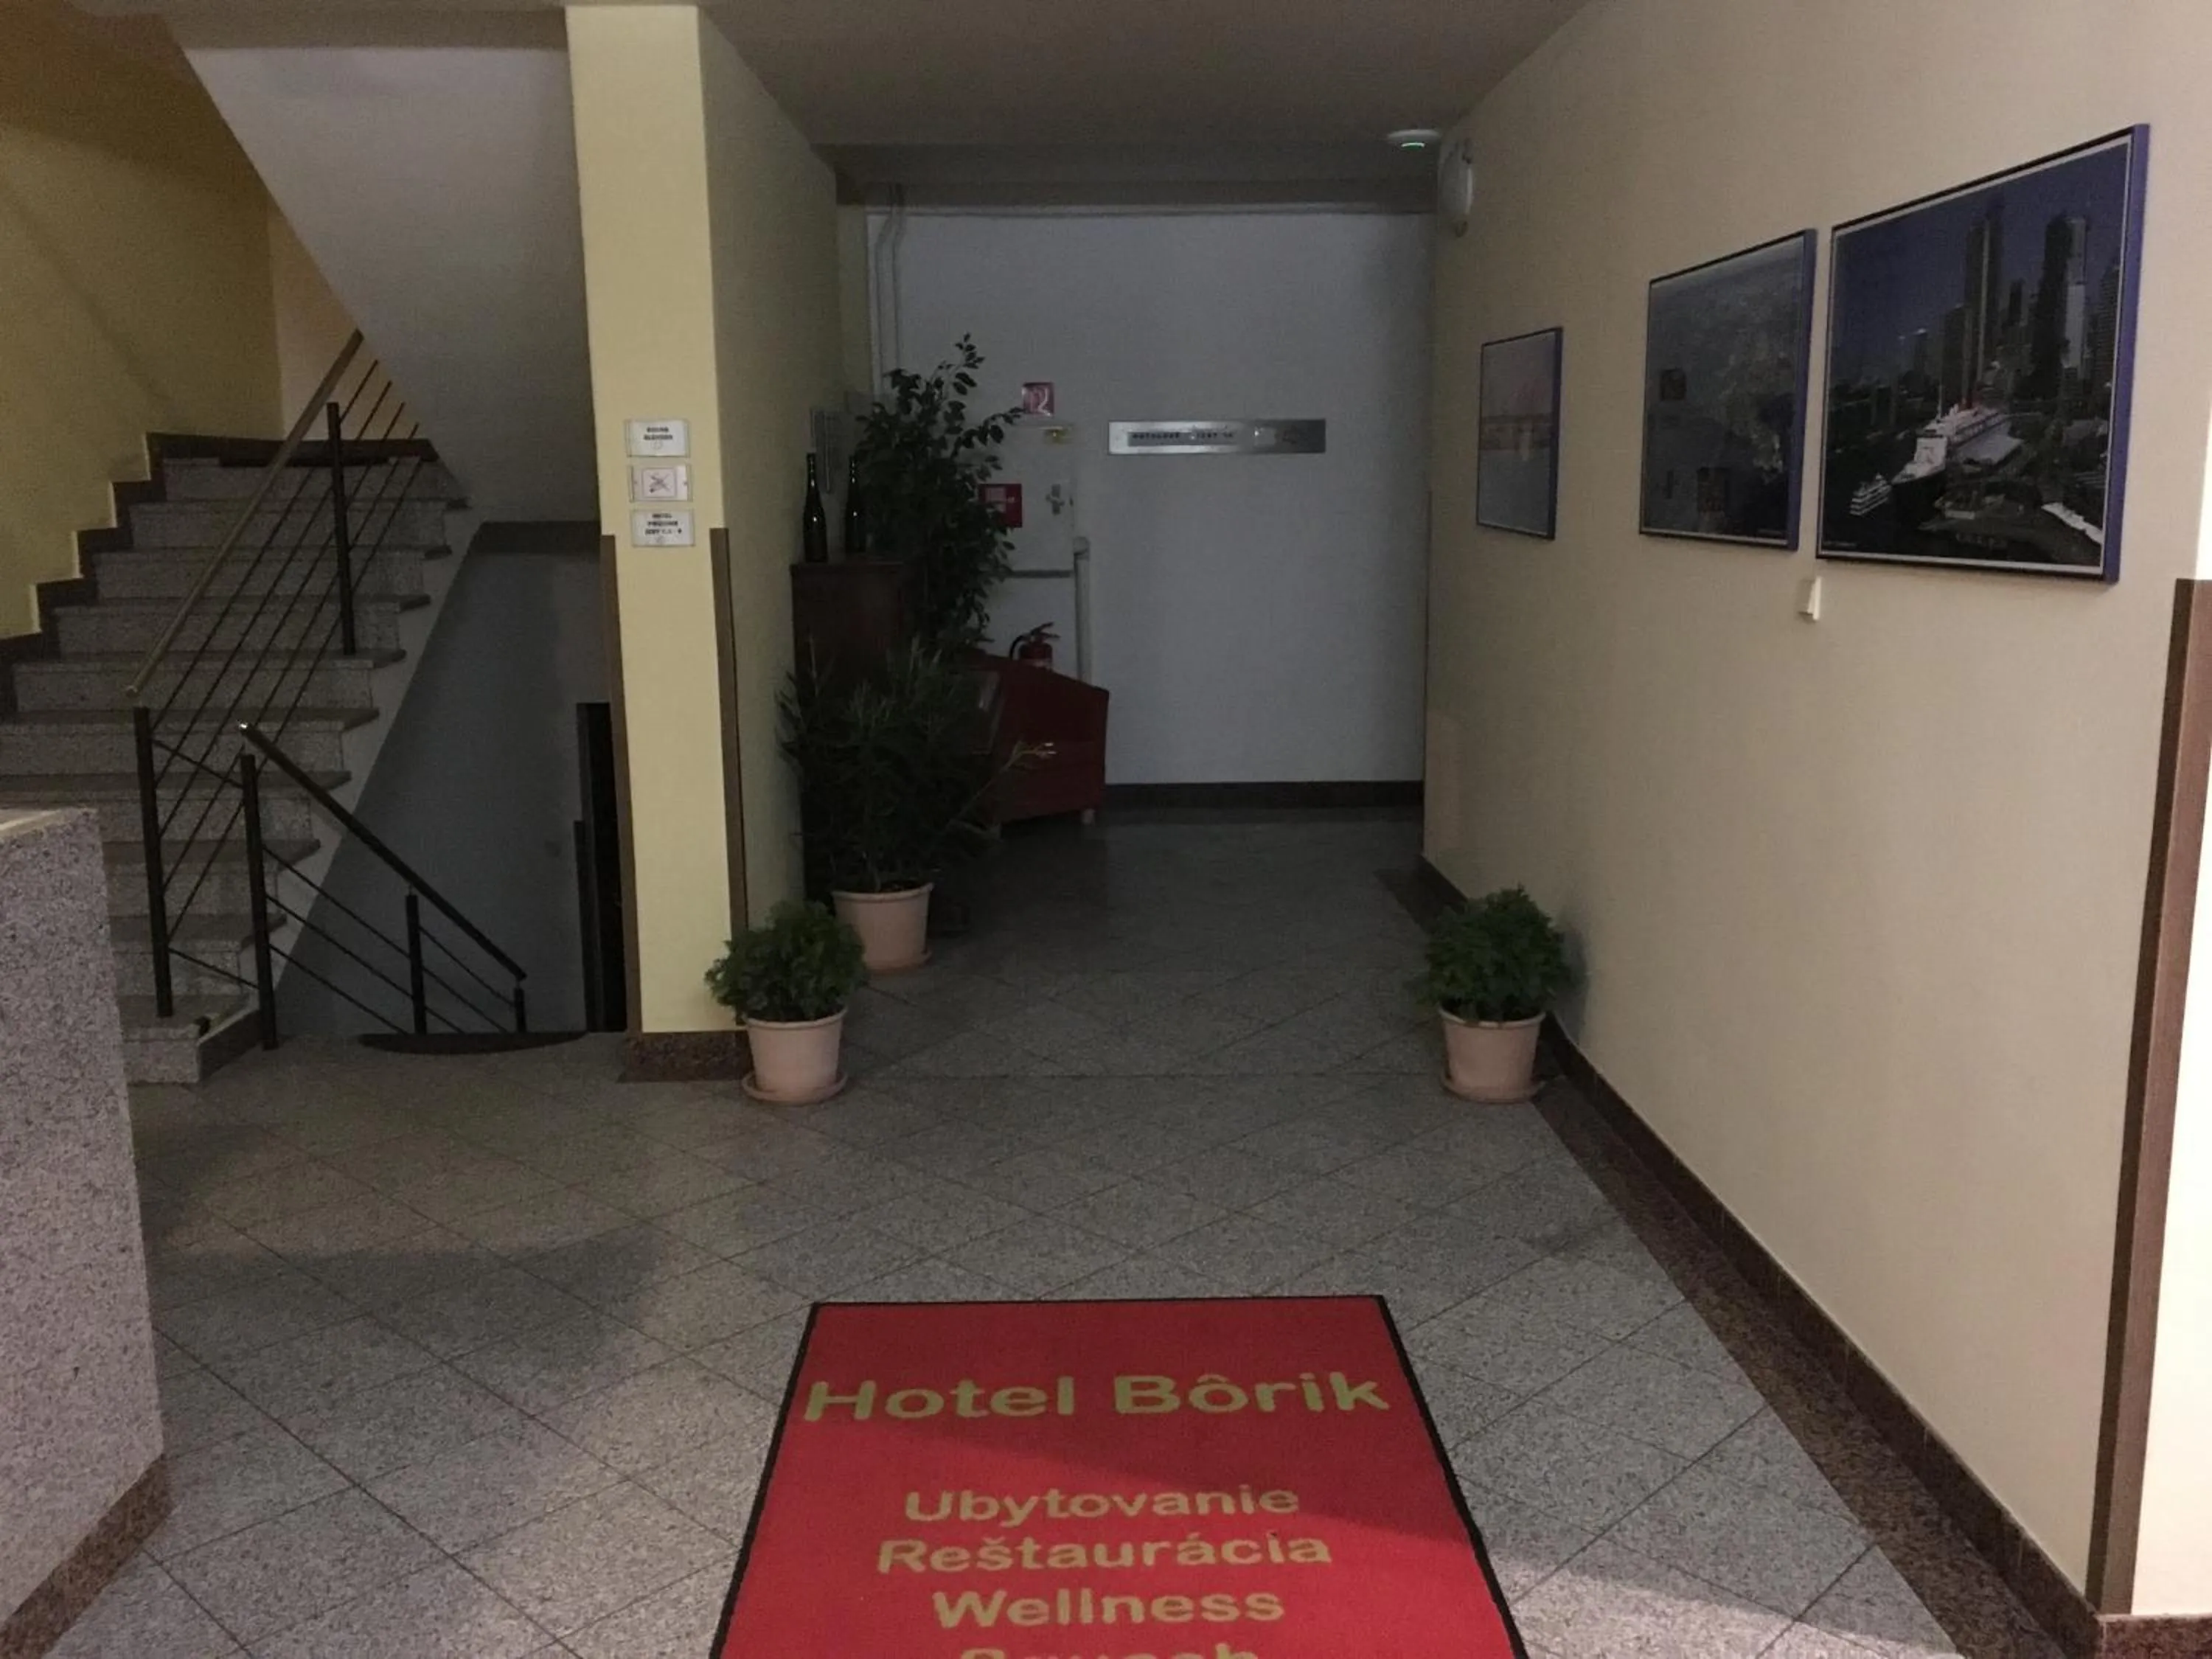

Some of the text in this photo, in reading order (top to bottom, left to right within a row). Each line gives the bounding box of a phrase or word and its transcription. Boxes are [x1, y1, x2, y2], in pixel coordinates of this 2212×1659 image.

[802, 1371, 1389, 1423] Hotel Bôrik
[904, 1484, 1301, 1528] Ubytovanie
[877, 1531, 1332, 1573] Reštaurácia
[932, 1587, 1284, 1630] Wellness
